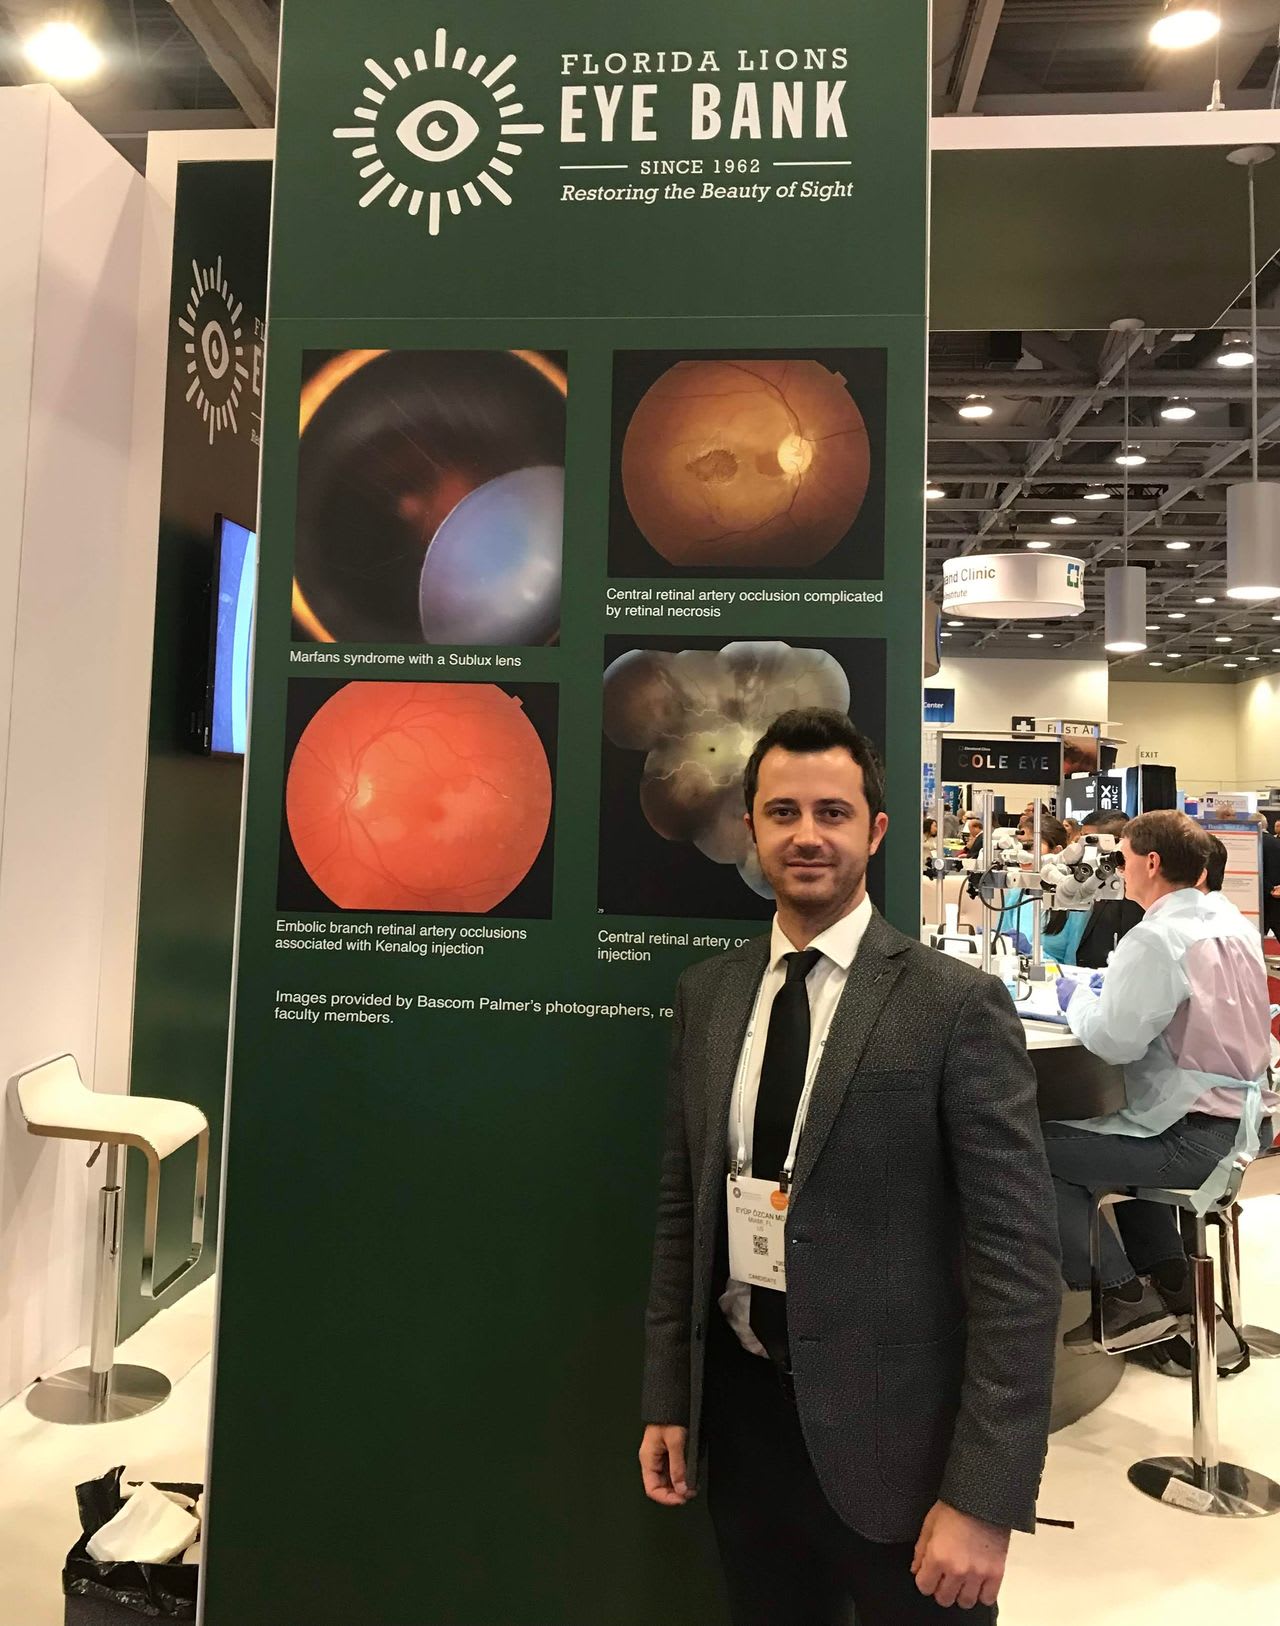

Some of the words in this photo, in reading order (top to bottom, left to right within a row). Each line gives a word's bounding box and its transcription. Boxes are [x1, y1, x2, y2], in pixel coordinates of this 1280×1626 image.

[561, 51, 720, 74] FLORIDA
[738, 48, 847, 70] LIONS
[561, 85, 657, 142] EYE
[692, 81, 847, 140] BANK
[641, 160, 703, 174] SINCE
[714, 159, 759, 173] 1962
[561, 184, 659, 204] Restoring
[665, 184, 695, 199] the
[701, 183, 771, 202] Beauty
[776, 182, 798, 197] of
[800, 181, 853, 201] Sight
[961, 566, 996, 582] Clinic
[607, 588, 651, 600] Central
[657, 589, 694, 600] retinal
[699, 590, 735, 603] artery
[740, 590, 799, 601] occlusion
[804, 591, 882, 604] complicated
[607, 605, 621, 618] by
[625, 605, 663, 616] retinal
[668, 606, 720, 617] necrosis
[290, 651, 340, 662] Marfans
[344, 653, 404, 665] syndrome
[409, 654, 433, 664] with
[438, 656, 445, 664] a
[449, 654, 491, 665] Sublux
[496, 655, 521, 666] lens
[959, 754, 1009, 769] COLE
[1018, 756, 1049, 770] EYE
[277, 920, 326, 932] Embolic
[330, 922, 372, 934] branch
[378, 924, 415, 935] retinal
[420, 926, 456, 939] artery
[460, 927, 526, 939] occlusions
[275, 938, 342, 950] associated
[347, 939, 371, 950] with
[376, 940, 427, 956] Kenalog
[432, 942, 483, 956] injection
[598, 930, 644, 943] Central
[649, 933, 688, 945] retinal
[693, 936, 730, 950] artery
[598, 948, 650, 962] injection
[276, 991, 326, 1006] Images
[331, 994, 391, 1006] provided
[396, 995, 413, 1009] by
[418, 996, 474, 1009] Bascom
[546, 1001, 653, 1018] photographers,
[275, 1007, 320, 1023] faculty
[325, 1011, 393, 1023] members.
